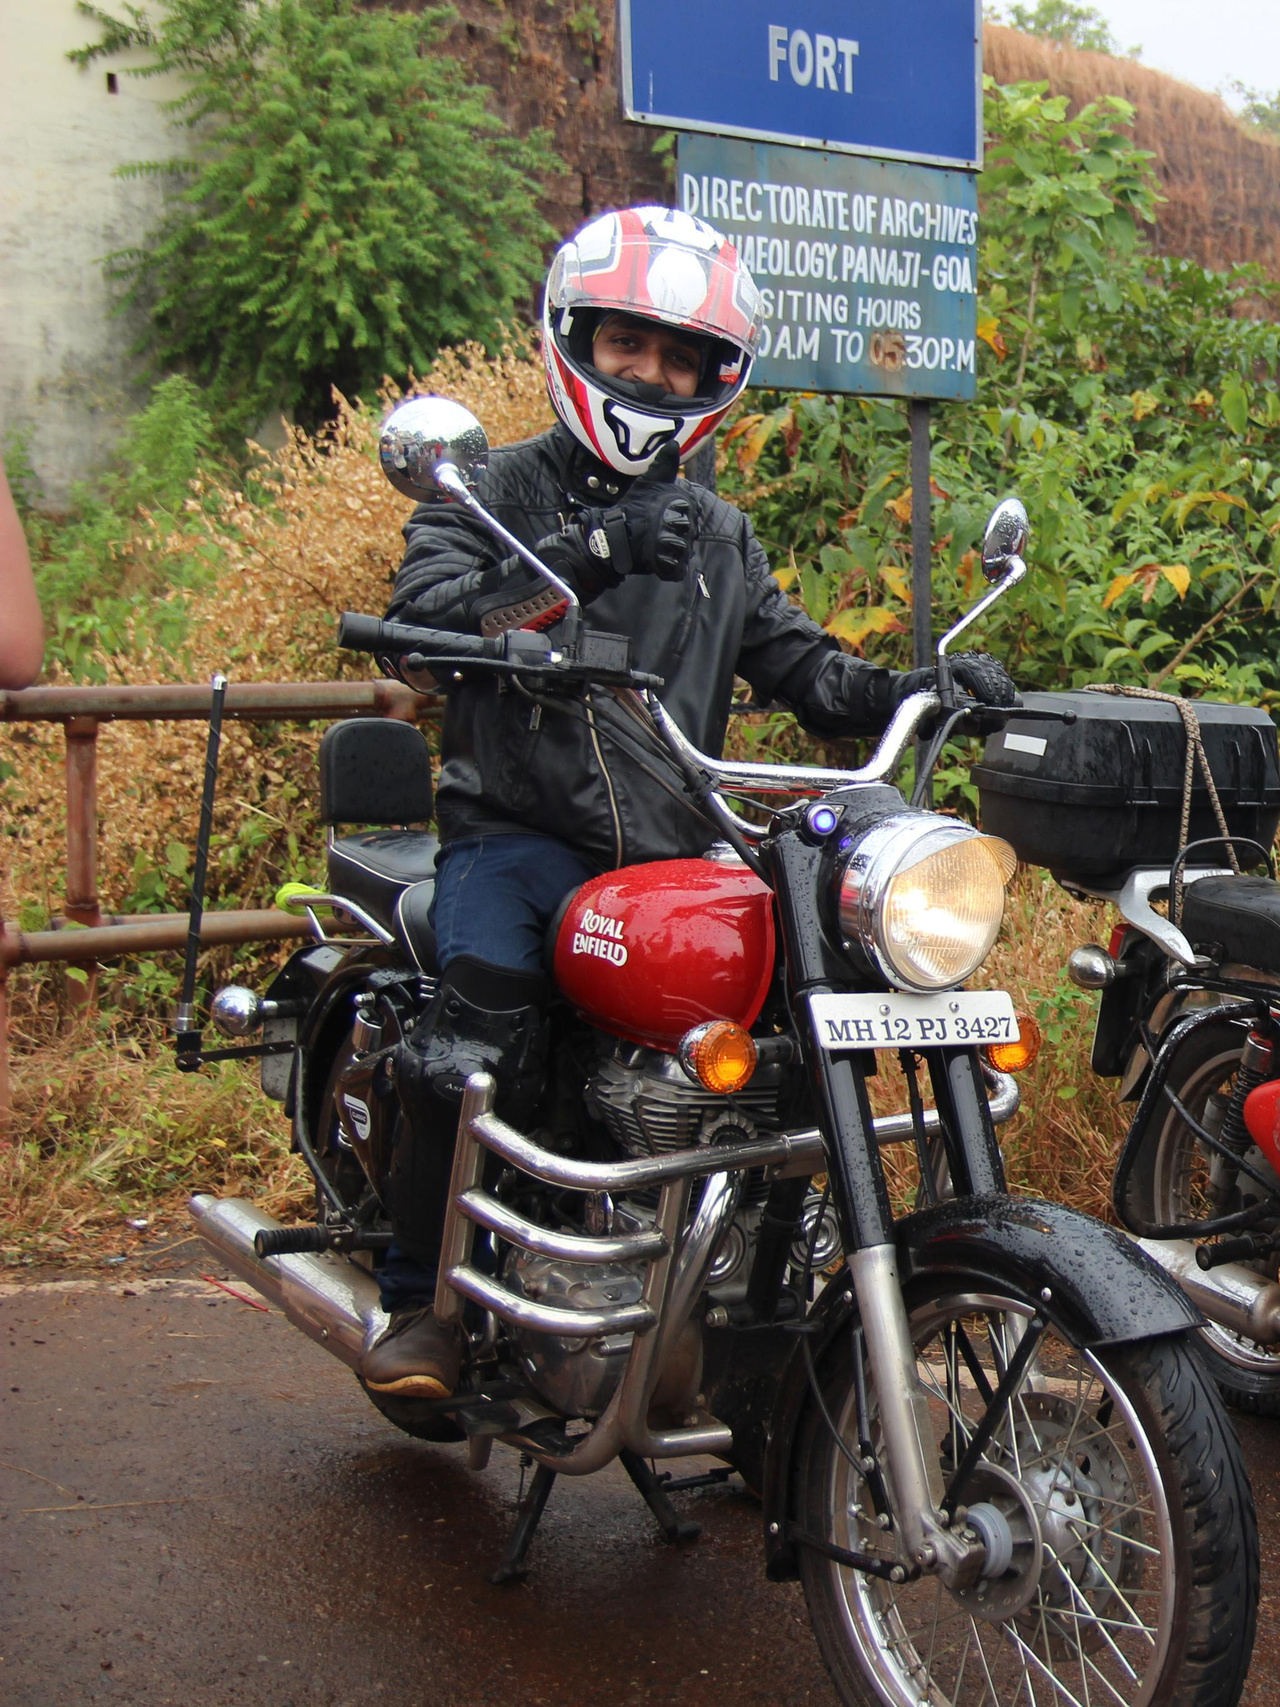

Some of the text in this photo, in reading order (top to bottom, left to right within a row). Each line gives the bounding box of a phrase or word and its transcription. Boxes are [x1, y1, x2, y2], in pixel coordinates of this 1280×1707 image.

[768, 24, 860, 94] FORT
[682, 173, 979, 246] DIRECTORATE OF ARCHIVES
[760, 288, 922, 331] SITING HOURS
[830, 328, 865, 364] TO
[580, 908, 625, 940] ROYAL
[572, 932, 628, 967] ENFIELD
[825, 1016, 1011, 1042] MH 12 PJ 3427
